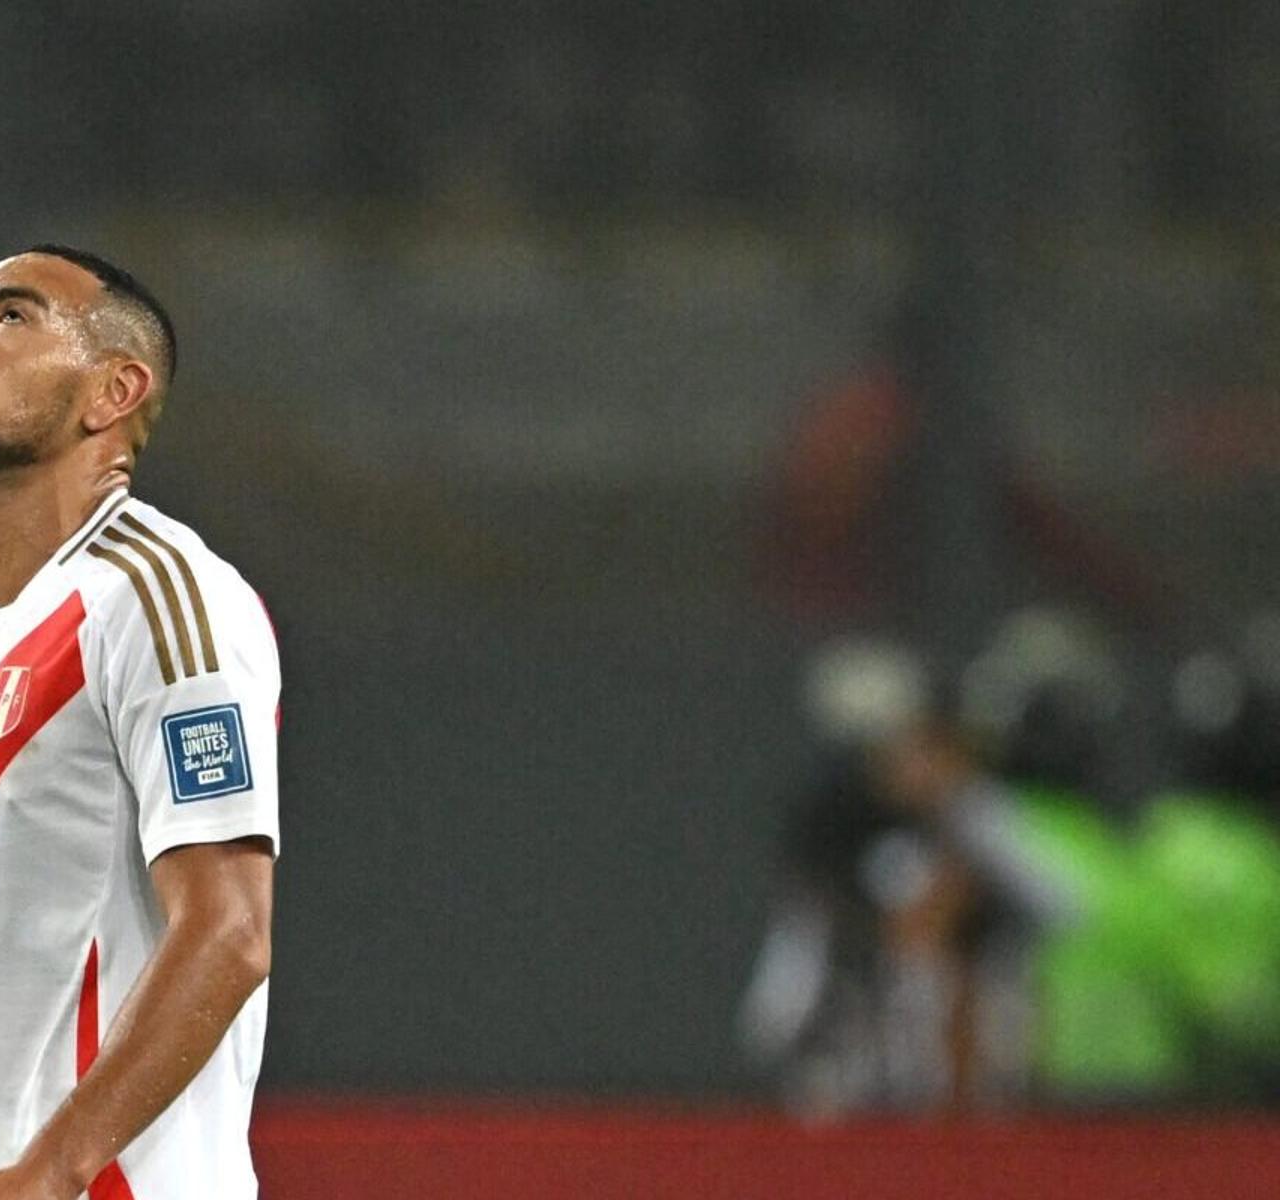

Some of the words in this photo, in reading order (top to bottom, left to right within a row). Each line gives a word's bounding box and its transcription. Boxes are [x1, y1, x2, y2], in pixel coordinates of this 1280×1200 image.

[180, 721, 226, 739] FOOTBALL
[182, 733, 229, 757] UNITES
[202, 748, 233, 769] World
